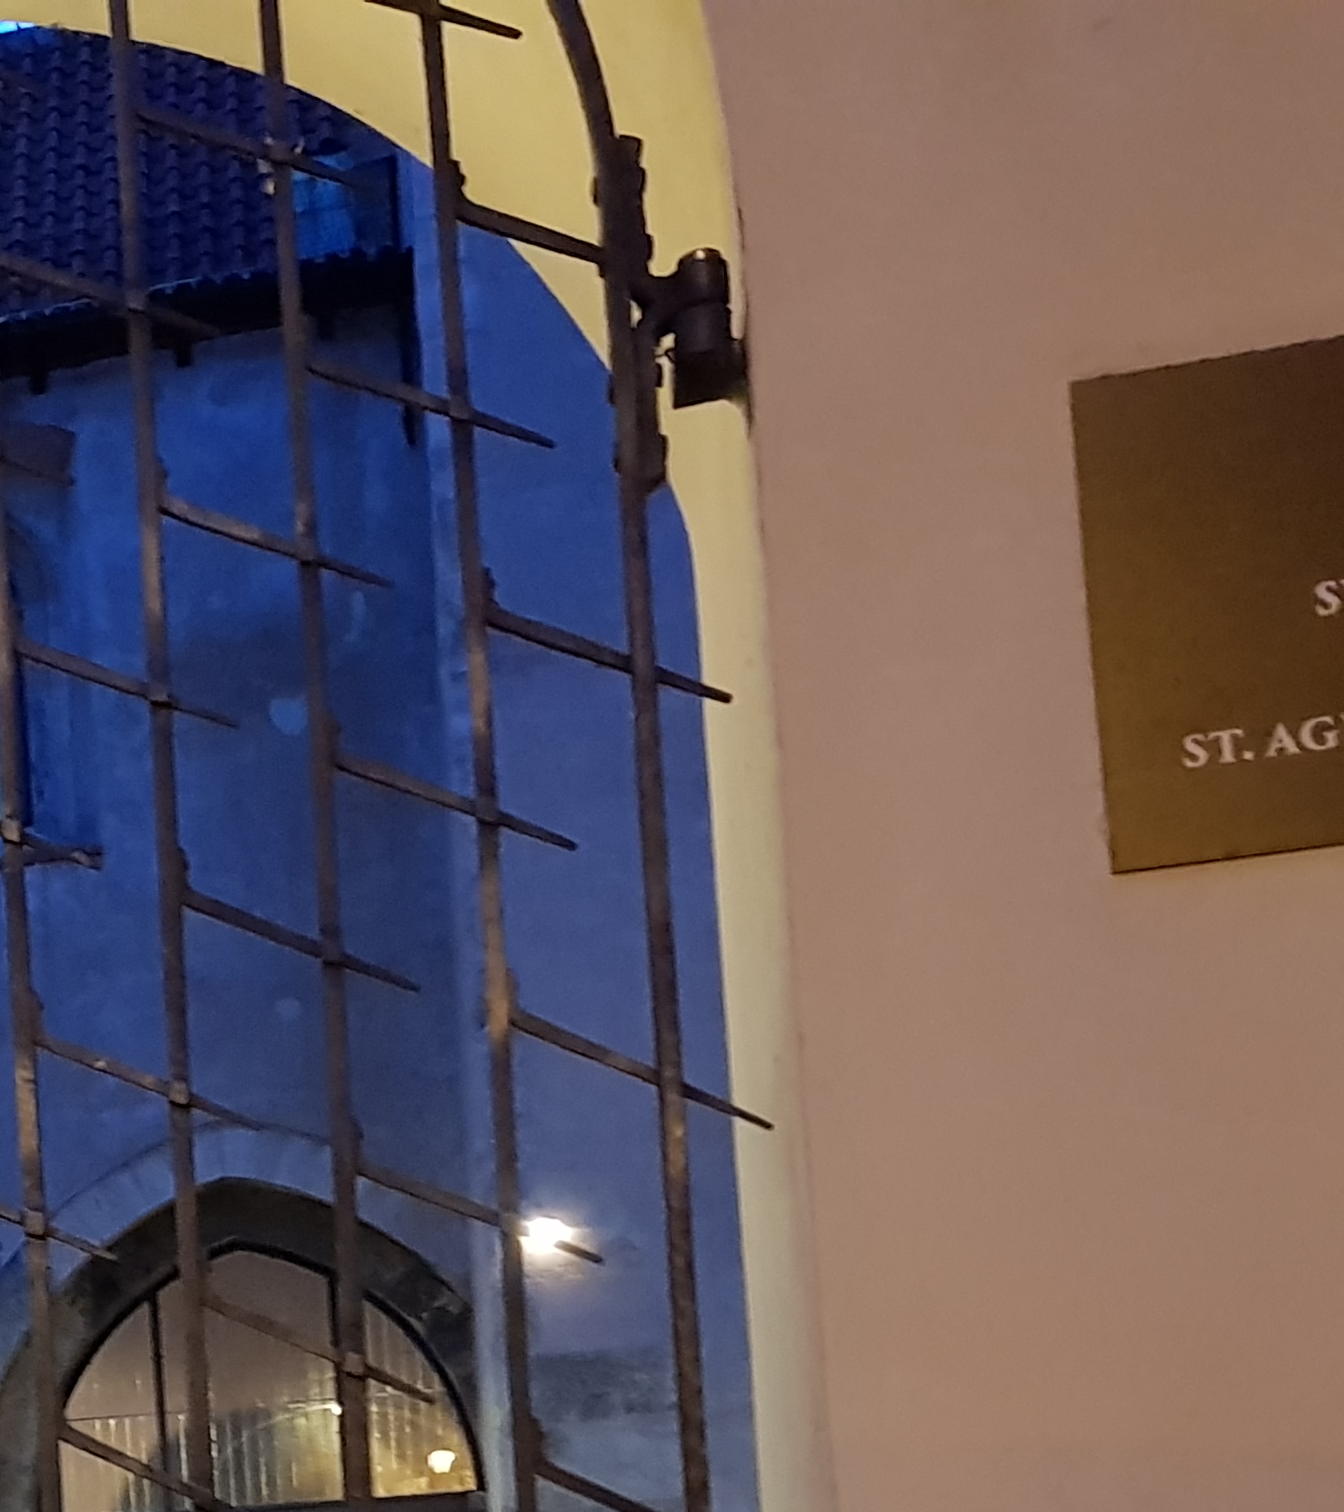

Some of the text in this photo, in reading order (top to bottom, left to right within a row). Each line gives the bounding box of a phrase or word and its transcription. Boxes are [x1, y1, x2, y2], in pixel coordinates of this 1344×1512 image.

[1314, 580, 1344, 616] S
[1182, 713, 1344, 768] ST. AG
